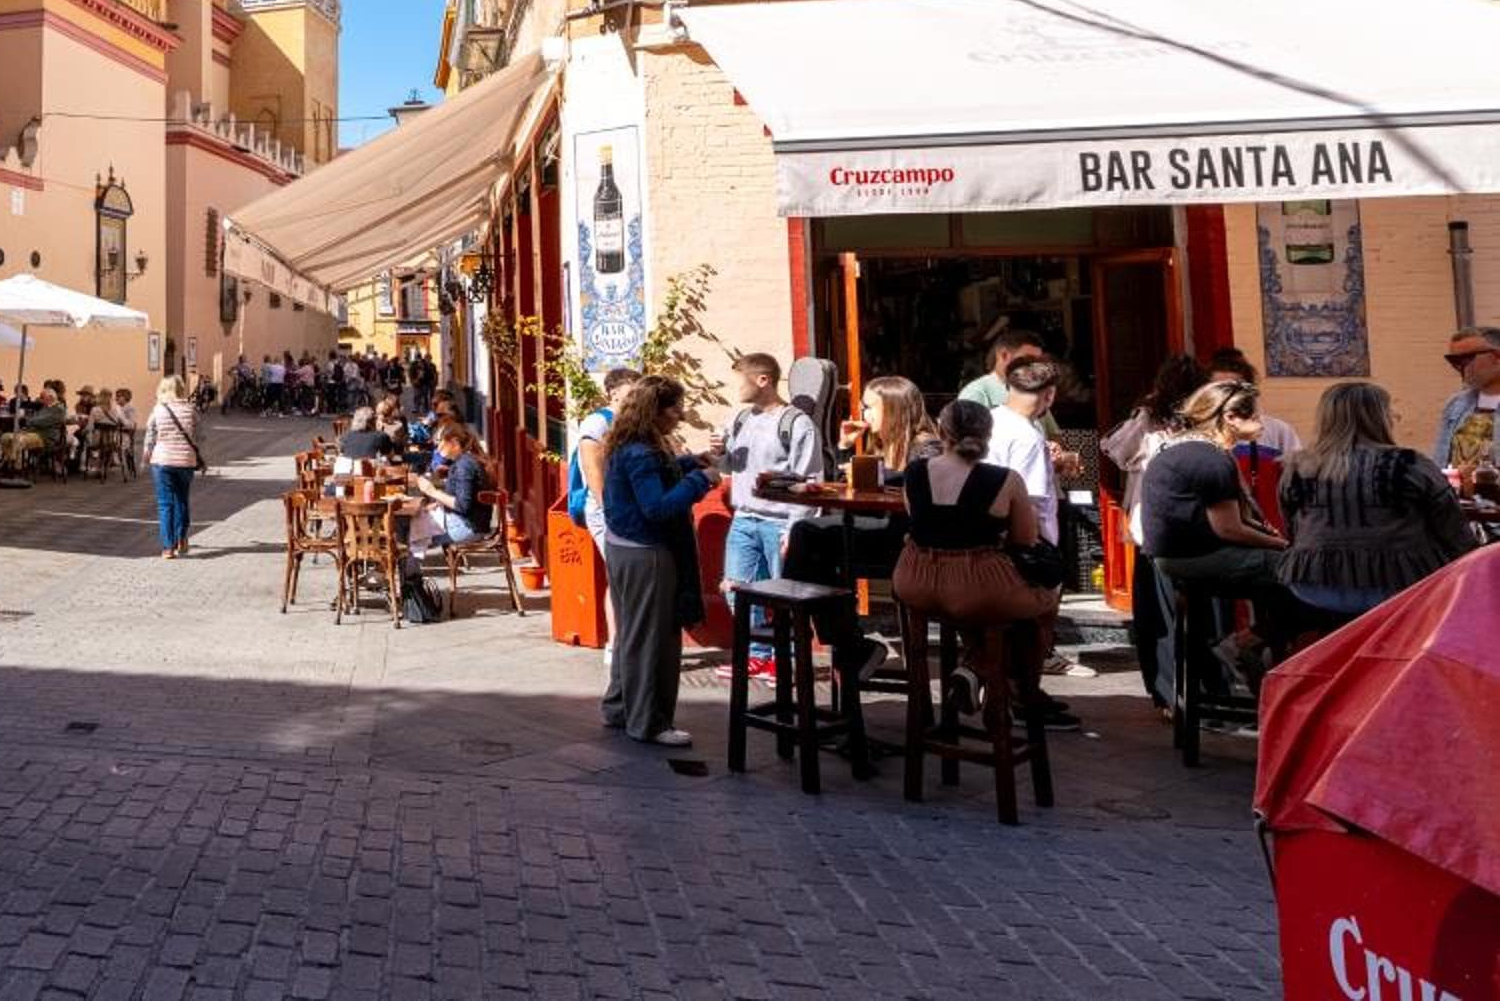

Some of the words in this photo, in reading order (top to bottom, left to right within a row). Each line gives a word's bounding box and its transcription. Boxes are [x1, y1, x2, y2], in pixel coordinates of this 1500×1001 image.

[830, 167, 954, 186] Cruzcampo
[1079, 150, 1155, 192] BAR
[1169, 145, 1296, 190] SANTA
[1311, 141, 1393, 185] ANA
